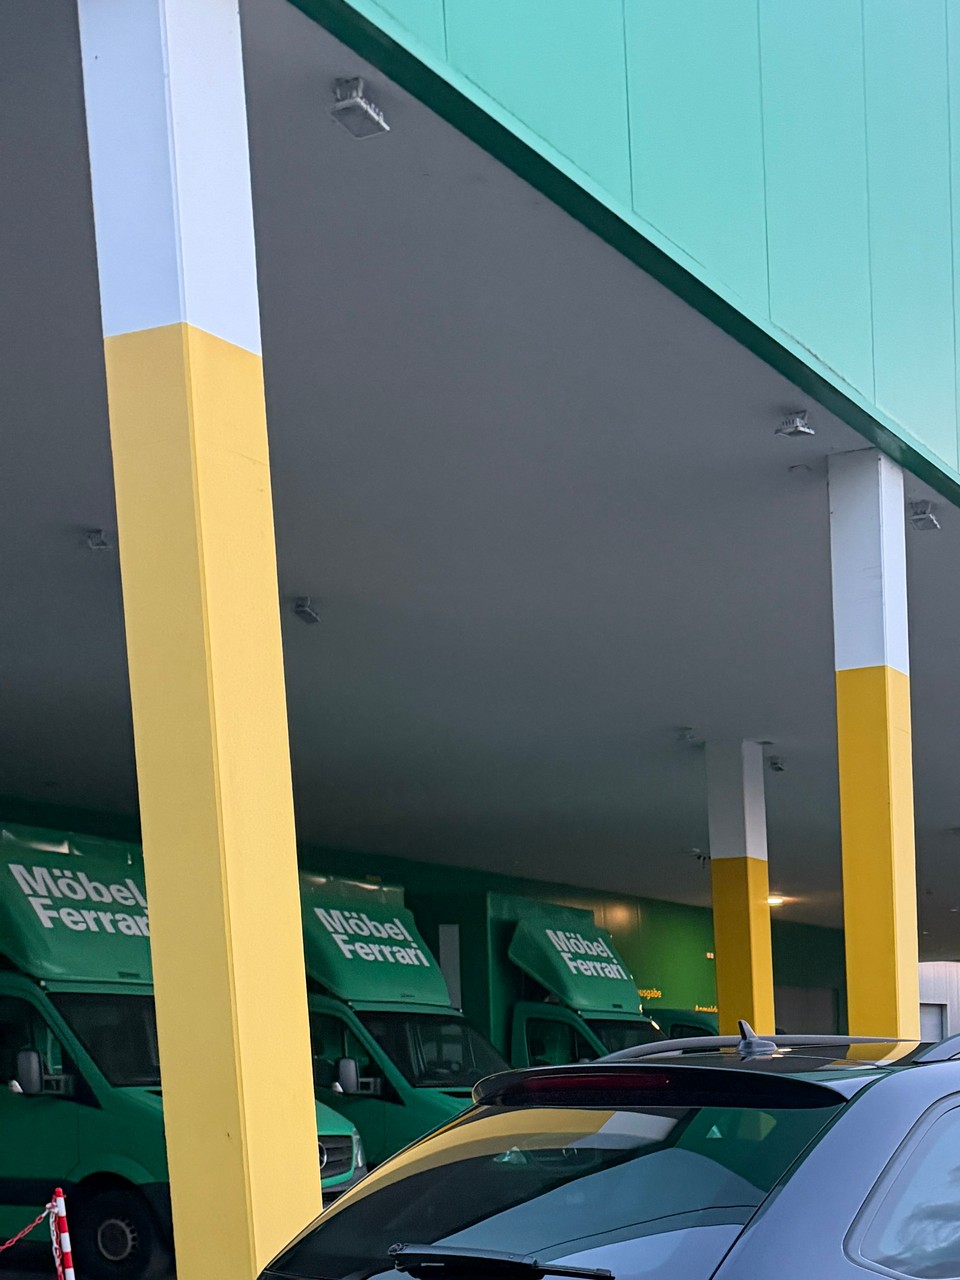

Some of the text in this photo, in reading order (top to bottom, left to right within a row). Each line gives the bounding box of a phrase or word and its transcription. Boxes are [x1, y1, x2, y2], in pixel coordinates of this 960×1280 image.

[8, 863, 148, 908] Möbel
[28, 895, 150, 937] Ferrar
[313, 907, 414, 942] Möbel
[331, 933, 431, 967] Ferrari
[545, 929, 614, 958] Möbel
[560, 952, 628, 980] Ferrari
